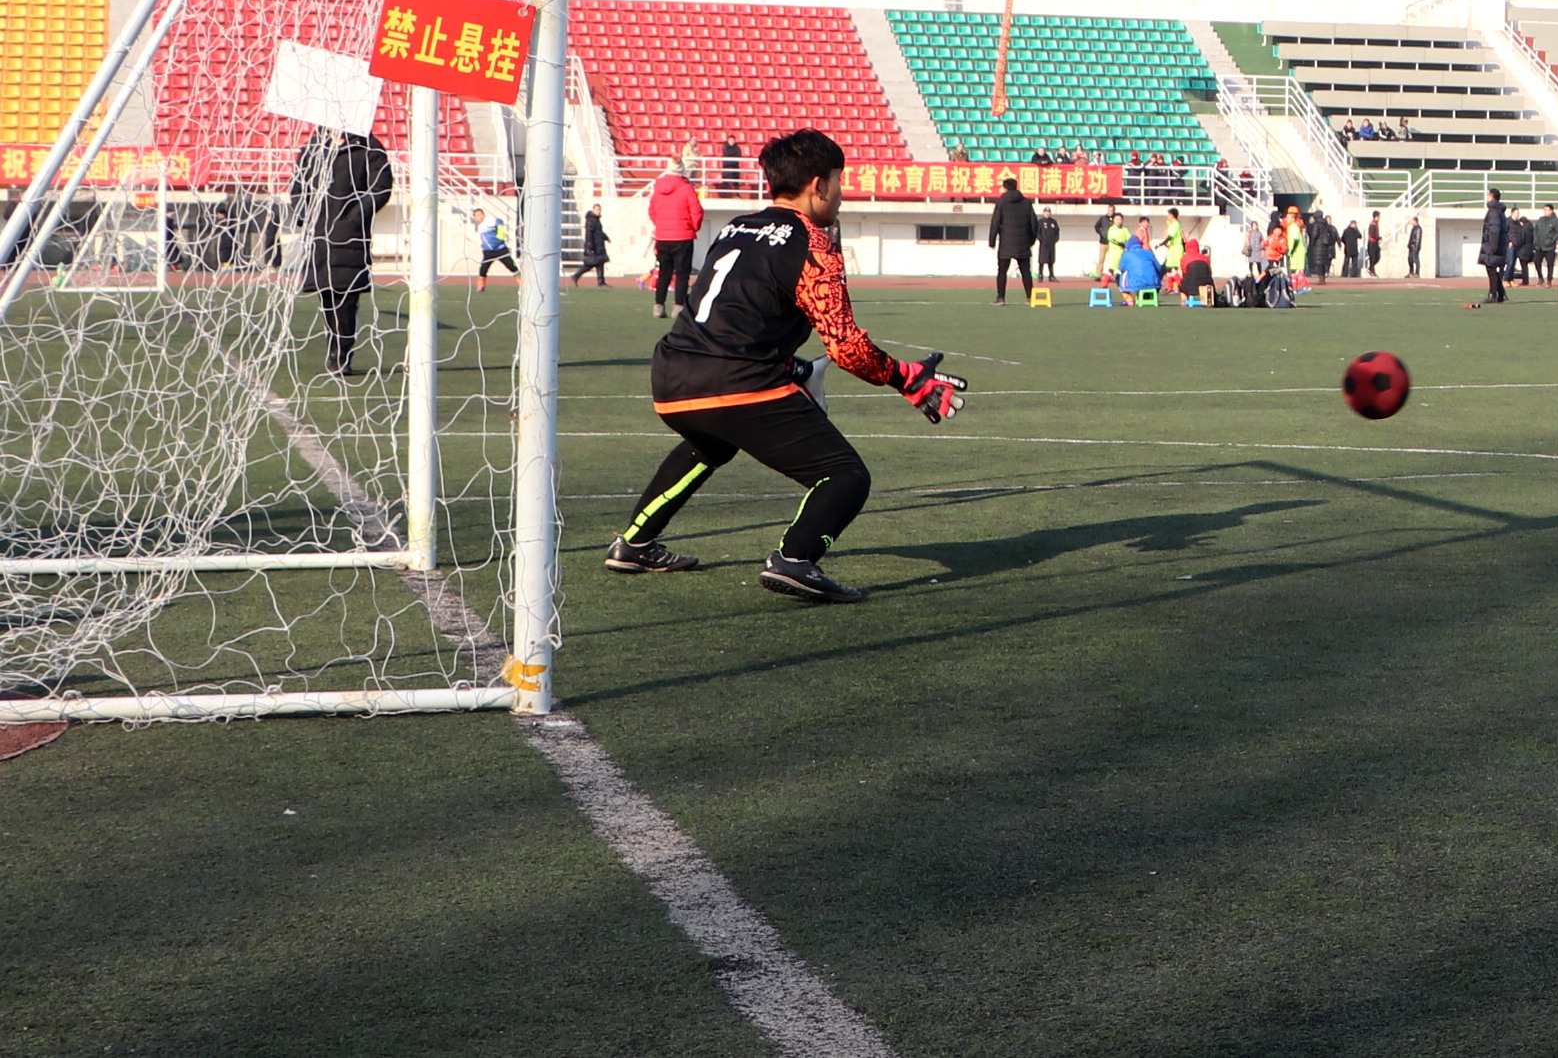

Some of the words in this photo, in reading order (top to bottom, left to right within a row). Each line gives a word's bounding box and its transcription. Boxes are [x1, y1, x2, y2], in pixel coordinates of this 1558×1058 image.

[379, 6, 521, 82] 禁止悬挂
[694, 248, 742, 323] 1
